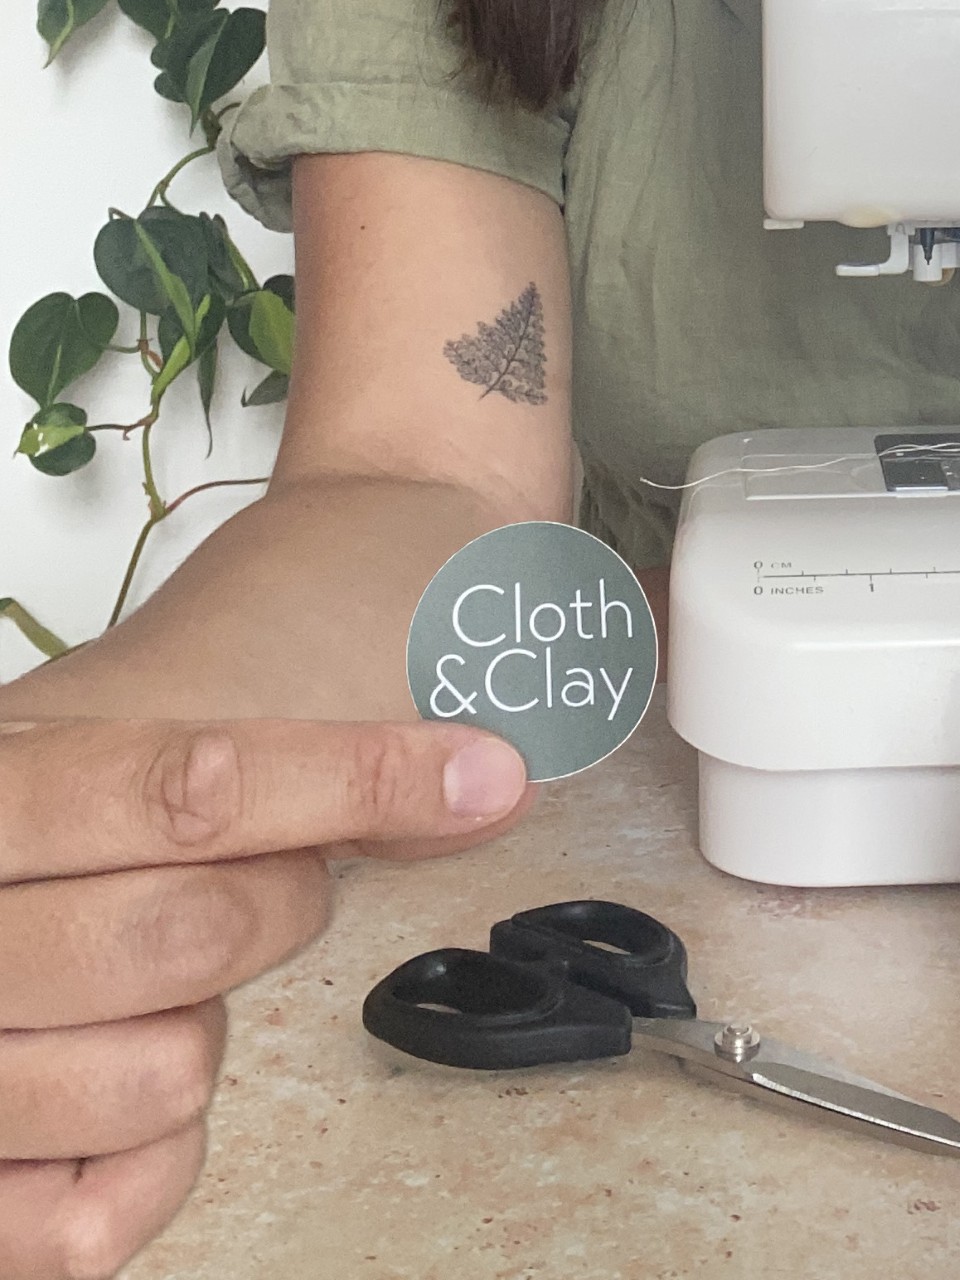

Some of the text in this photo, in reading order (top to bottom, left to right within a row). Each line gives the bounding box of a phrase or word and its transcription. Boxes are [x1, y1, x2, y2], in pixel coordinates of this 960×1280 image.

[753, 560, 764, 570] 0
[753, 585, 764, 596] 0
[770, 586, 825, 595] INCHES
[869, 583, 875, 592] 1
[452, 578, 633, 648] Cloth
[429, 646, 634, 721] &Clay
